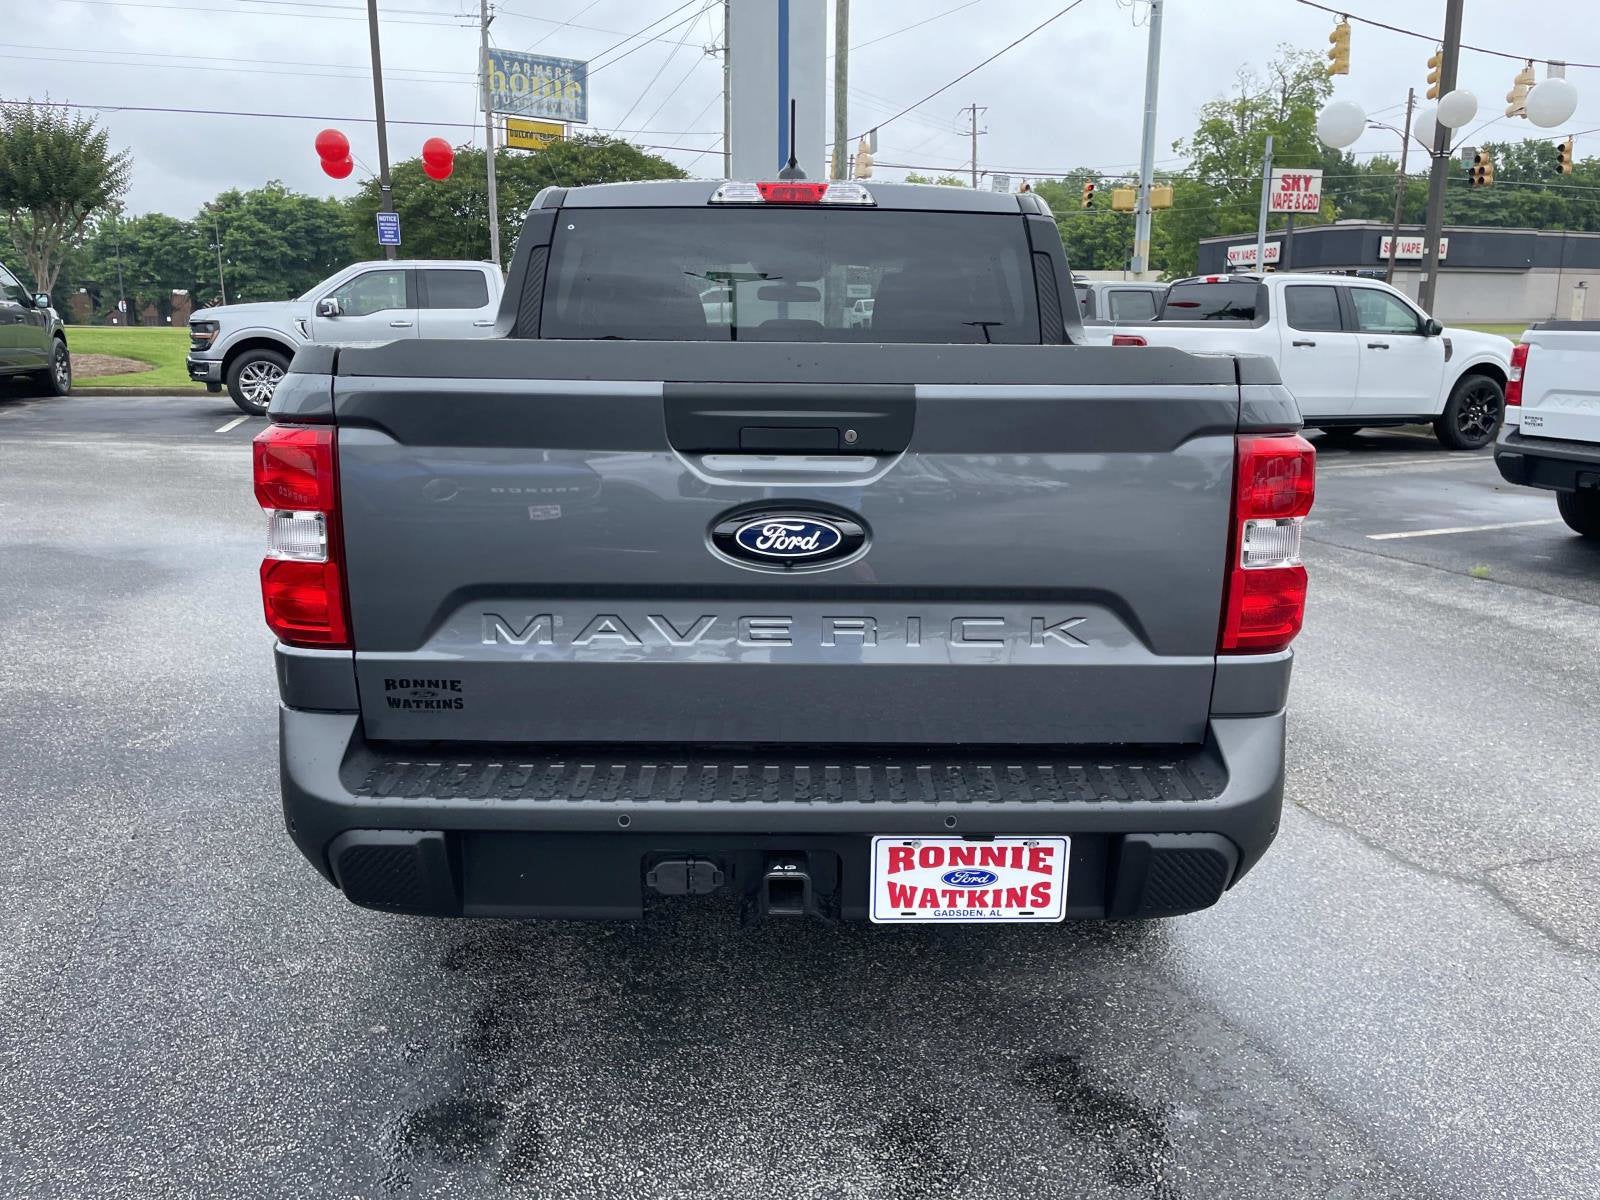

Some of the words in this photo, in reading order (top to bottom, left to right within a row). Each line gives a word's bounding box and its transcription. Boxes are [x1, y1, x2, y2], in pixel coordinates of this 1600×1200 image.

[503, 60, 571, 75] FARMERS
[488, 59, 581, 100] home
[1281, 174, 1312, 191] SKY
[1272, 193, 1293, 209] VAPE
[1294, 194, 1301, 209] &
[1302, 194, 1318, 210] CBD
[1229, 250, 1241, 261] SKY
[1242, 249, 1257, 260] VAPE
[1264, 247, 1278, 259] CBD
[1401, 242, 1422, 254] VAPE
[755, 523, 822, 550] Ford
[482, 612, 1091, 647] MAVERICK
[383, 678, 463, 692] RONNIE
[386, 696, 464, 709] WATKINS
[887, 846, 1055, 875] RONNIE
[950, 870, 990, 885] Ford
[887, 881, 1052, 909] WATKINS
[933, 909, 986, 917] GADSDEN,
[989, 909, 1003, 917] AL
